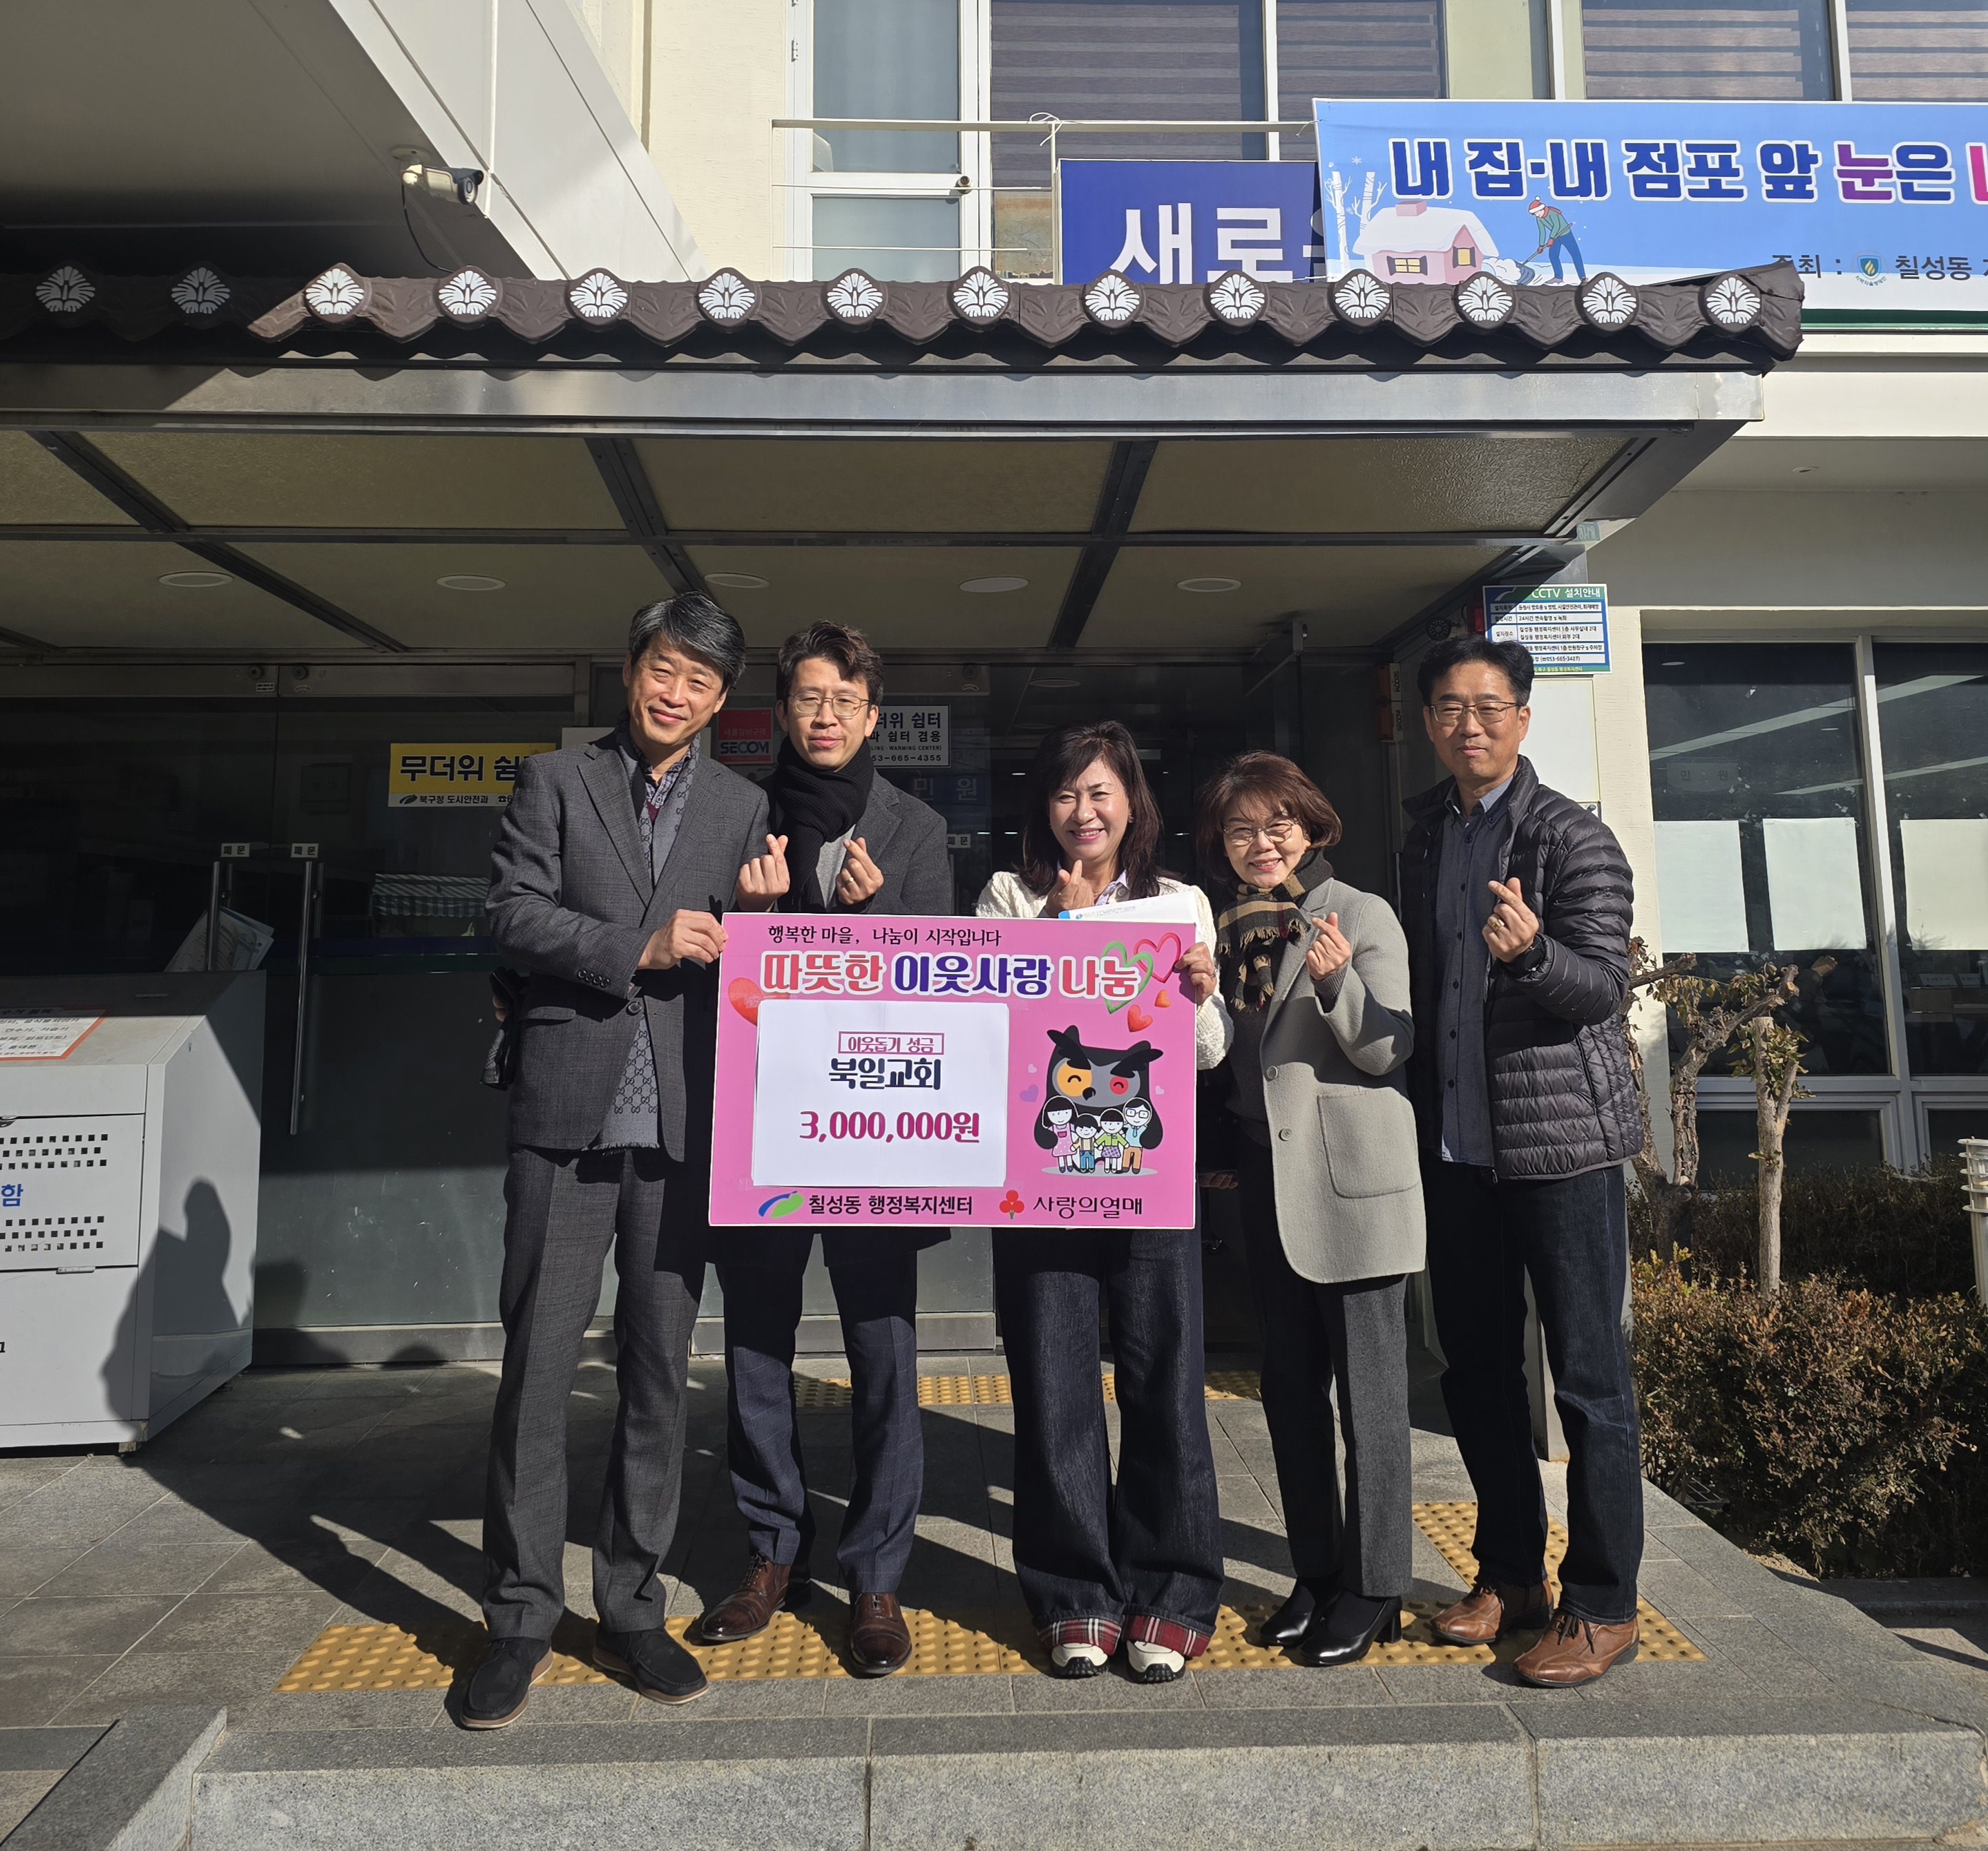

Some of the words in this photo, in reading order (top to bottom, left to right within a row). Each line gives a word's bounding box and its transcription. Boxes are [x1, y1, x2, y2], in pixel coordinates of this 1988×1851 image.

[1390, 140, 1451, 198] 내
[1623, 141, 1746, 200] 점포
[1758, 142, 1820, 200] 앞
[1835, 142, 1954, 202] 눈은
[1109, 202, 1324, 283] 새로
[1895, 255, 1973, 280] 칠성동
[1531, 588, 1561, 599] CCTV
[1565, 587, 1600, 599] 설치안내
[877, 712, 903, 729] 더위
[911, 712, 941, 729] 쉼터
[720, 740, 770, 754] SECOM
[870, 731, 880, 742] 파
[888, 731, 910, 742] 쉼터
[918, 731, 941, 742] 겸용
[399, 754, 484, 782] 무더위
[494, 754, 531, 782] 쉼
[419, 795, 444, 804] 북구청
[447, 795, 489, 805] 도시안전과
[768, 925, 817, 944] 행복한
[821, 926, 860, 945] 마을,
[872, 927, 919, 946] 나눔이
[926, 928, 1002, 947] 시작입니다
[763, 952, 884, 992] 따뜻한
[893, 955, 1051, 996] 이웃사랑
[1061, 957, 1138, 997] 나눔
[848, 1036, 901, 1053] 이웃돕기
[906, 1037, 935, 1053] 성금
[828, 1057, 942, 1091] 북일교회
[799, 1110, 980, 1144] 3,000,000원
[807, 1194, 862, 1216] 칠성동
[868, 1195, 973, 1216] 행정복지센터
[1032, 1196, 1143, 1219] 사랑의열매
